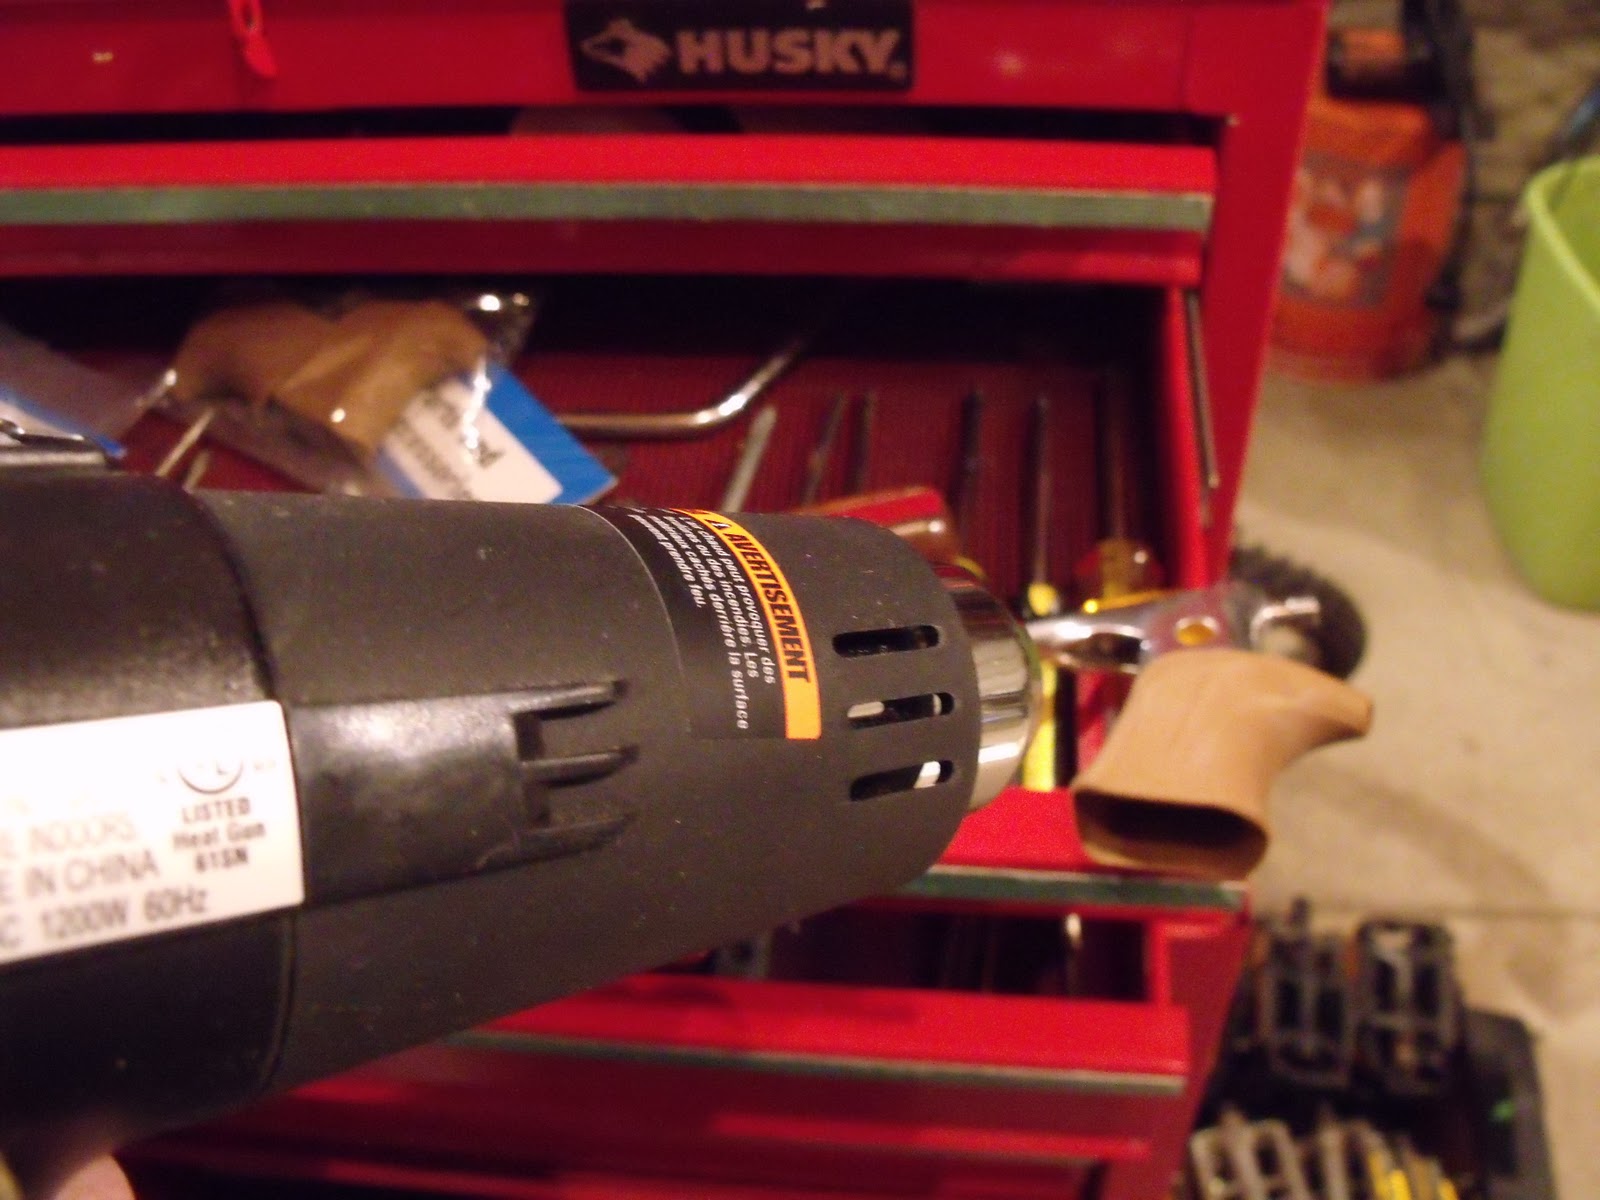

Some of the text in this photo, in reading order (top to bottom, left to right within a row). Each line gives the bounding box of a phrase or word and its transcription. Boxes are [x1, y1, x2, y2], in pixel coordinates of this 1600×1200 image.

[675, 29, 900, 76] HUSKY
[658, 541, 696, 582] prendre
[695, 544, 713, 557] ou
[706, 558, 727, 578] des
[719, 580, 752, 648] incendies.
[744, 651, 760, 678] Les
[698, 530, 731, 557] chaud
[719, 557, 746, 583] peut
[734, 584, 770, 654] provoquer
[761, 656, 776, 684] des
[723, 533, 812, 683] AVERTISEMENT
[728, 651, 742, 666] la
[731, 669, 750, 729] surface
[182, 797, 250, 824] LISTED
[172, 822, 266, 850] Heat Gun
[64, 848, 159, 892] CHINA
